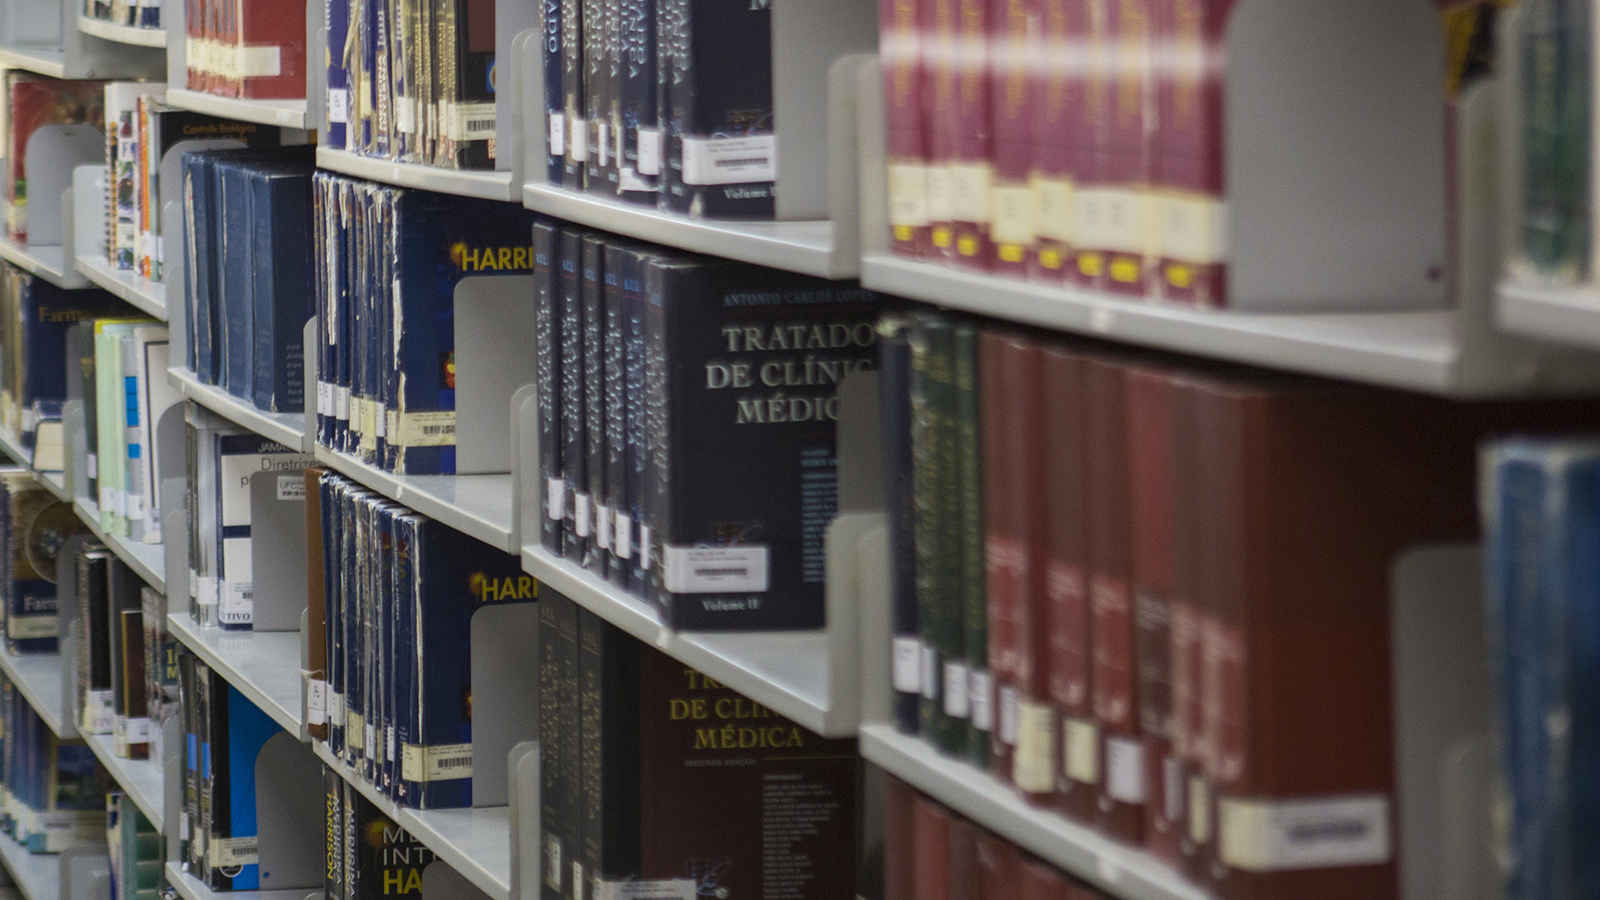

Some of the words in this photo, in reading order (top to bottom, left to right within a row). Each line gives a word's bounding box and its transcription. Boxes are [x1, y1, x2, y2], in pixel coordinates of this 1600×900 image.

[721, 323, 876, 352] TRATADO
[705, 363, 754, 389] DE
[702, 599, 746, 611] Volume
[670, 700, 708, 720] DE
[694, 724, 804, 749] MÉDICA
